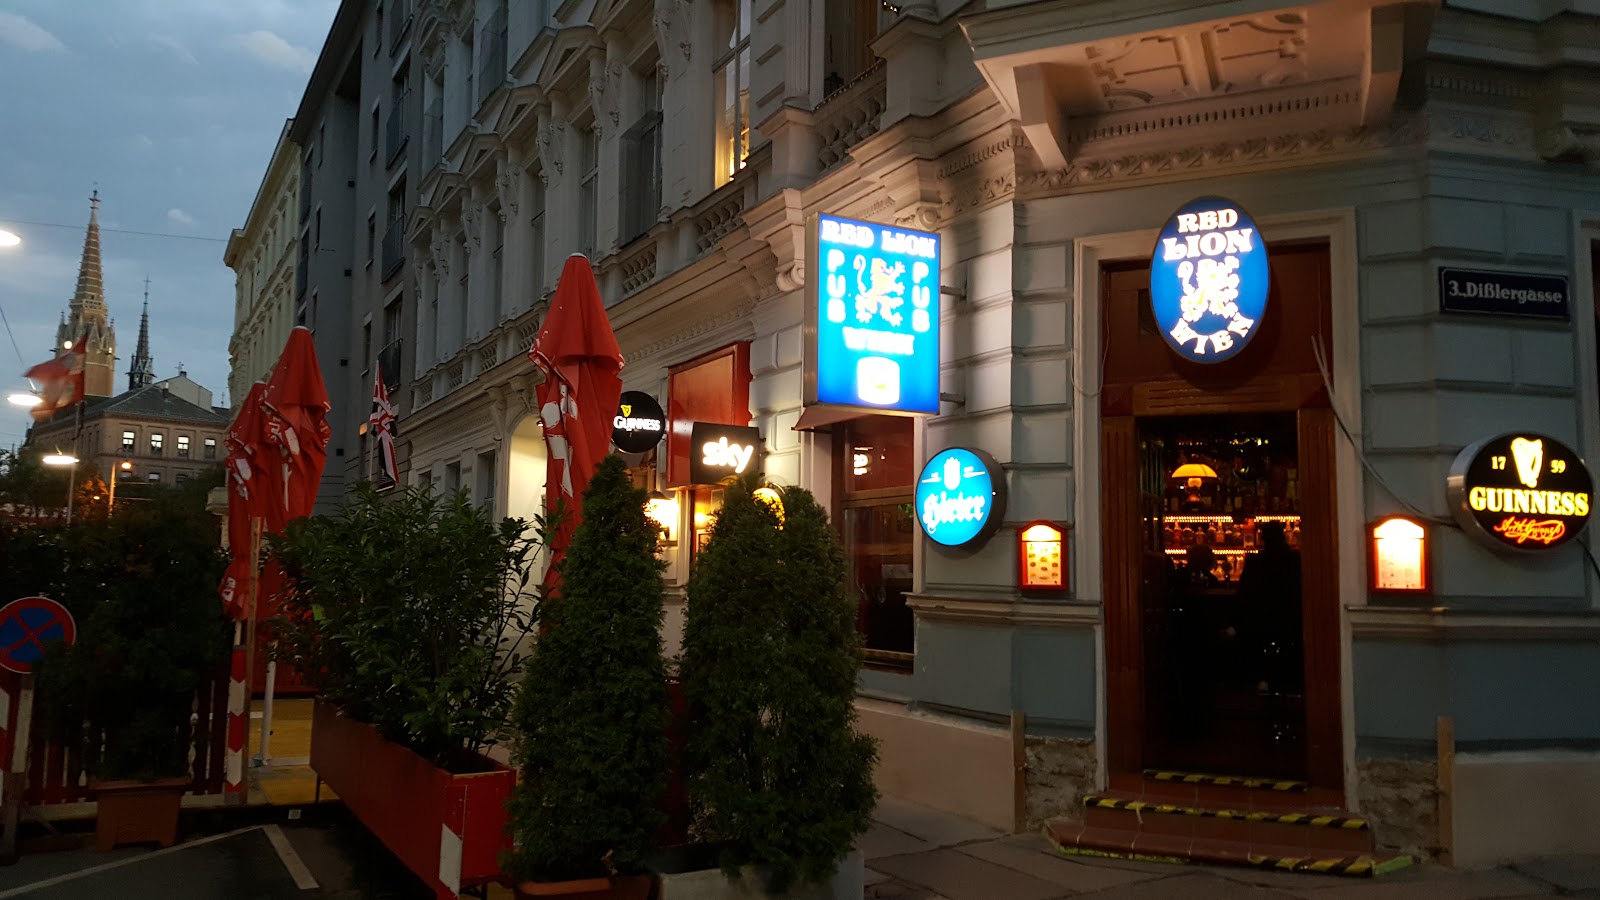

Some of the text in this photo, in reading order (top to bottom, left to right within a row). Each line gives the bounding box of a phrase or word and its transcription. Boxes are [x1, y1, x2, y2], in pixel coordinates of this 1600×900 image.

[1177, 208, 1238, 233] RED
[882, 230, 936, 259] LION
[1163, 229, 1253, 261] LION
[827, 249, 846, 323] PUB
[911, 261, 930, 332] PUB
[702, 436, 754, 474] sky
[1491, 456, 1566, 473] 17 59
[1469, 486, 1589, 516] GUINNESS
